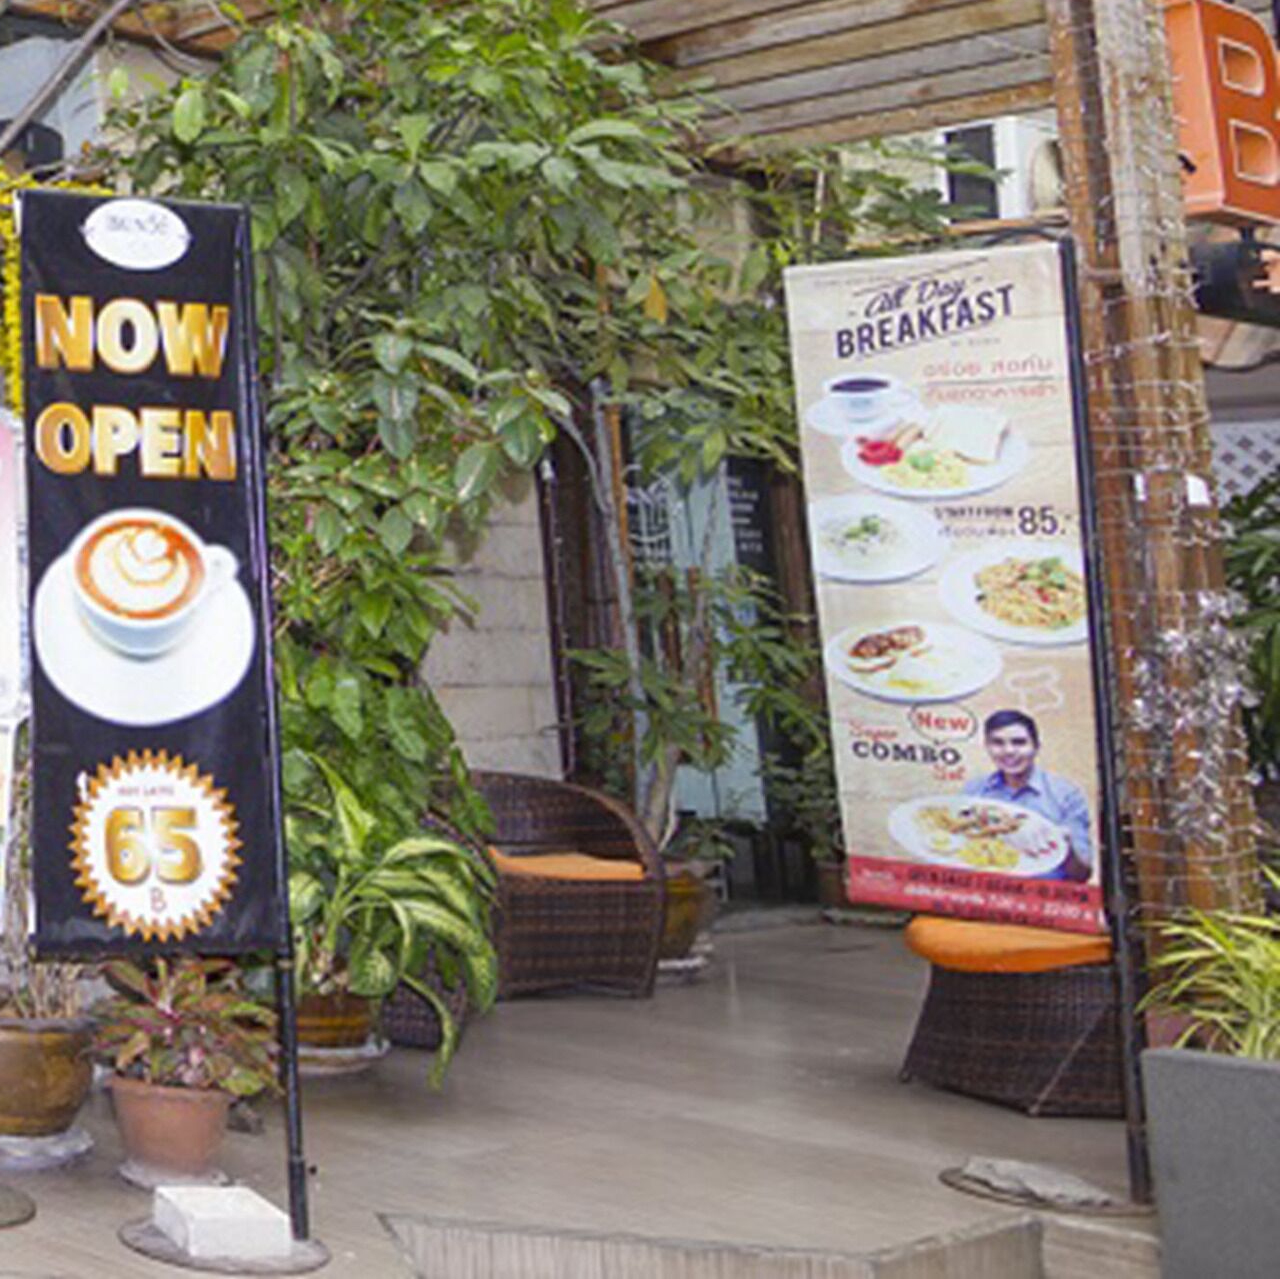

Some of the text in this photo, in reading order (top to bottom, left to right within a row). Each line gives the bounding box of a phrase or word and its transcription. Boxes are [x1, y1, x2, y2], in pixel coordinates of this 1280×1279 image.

[35, 294, 229, 379] NOW
[836, 284, 1016, 359] BREAKFAST
[35, 401, 238, 481] OPEN
[852, 740, 961, 766] COMBO
[918, 711, 971, 732] New
[105, 805, 205, 887] 65
